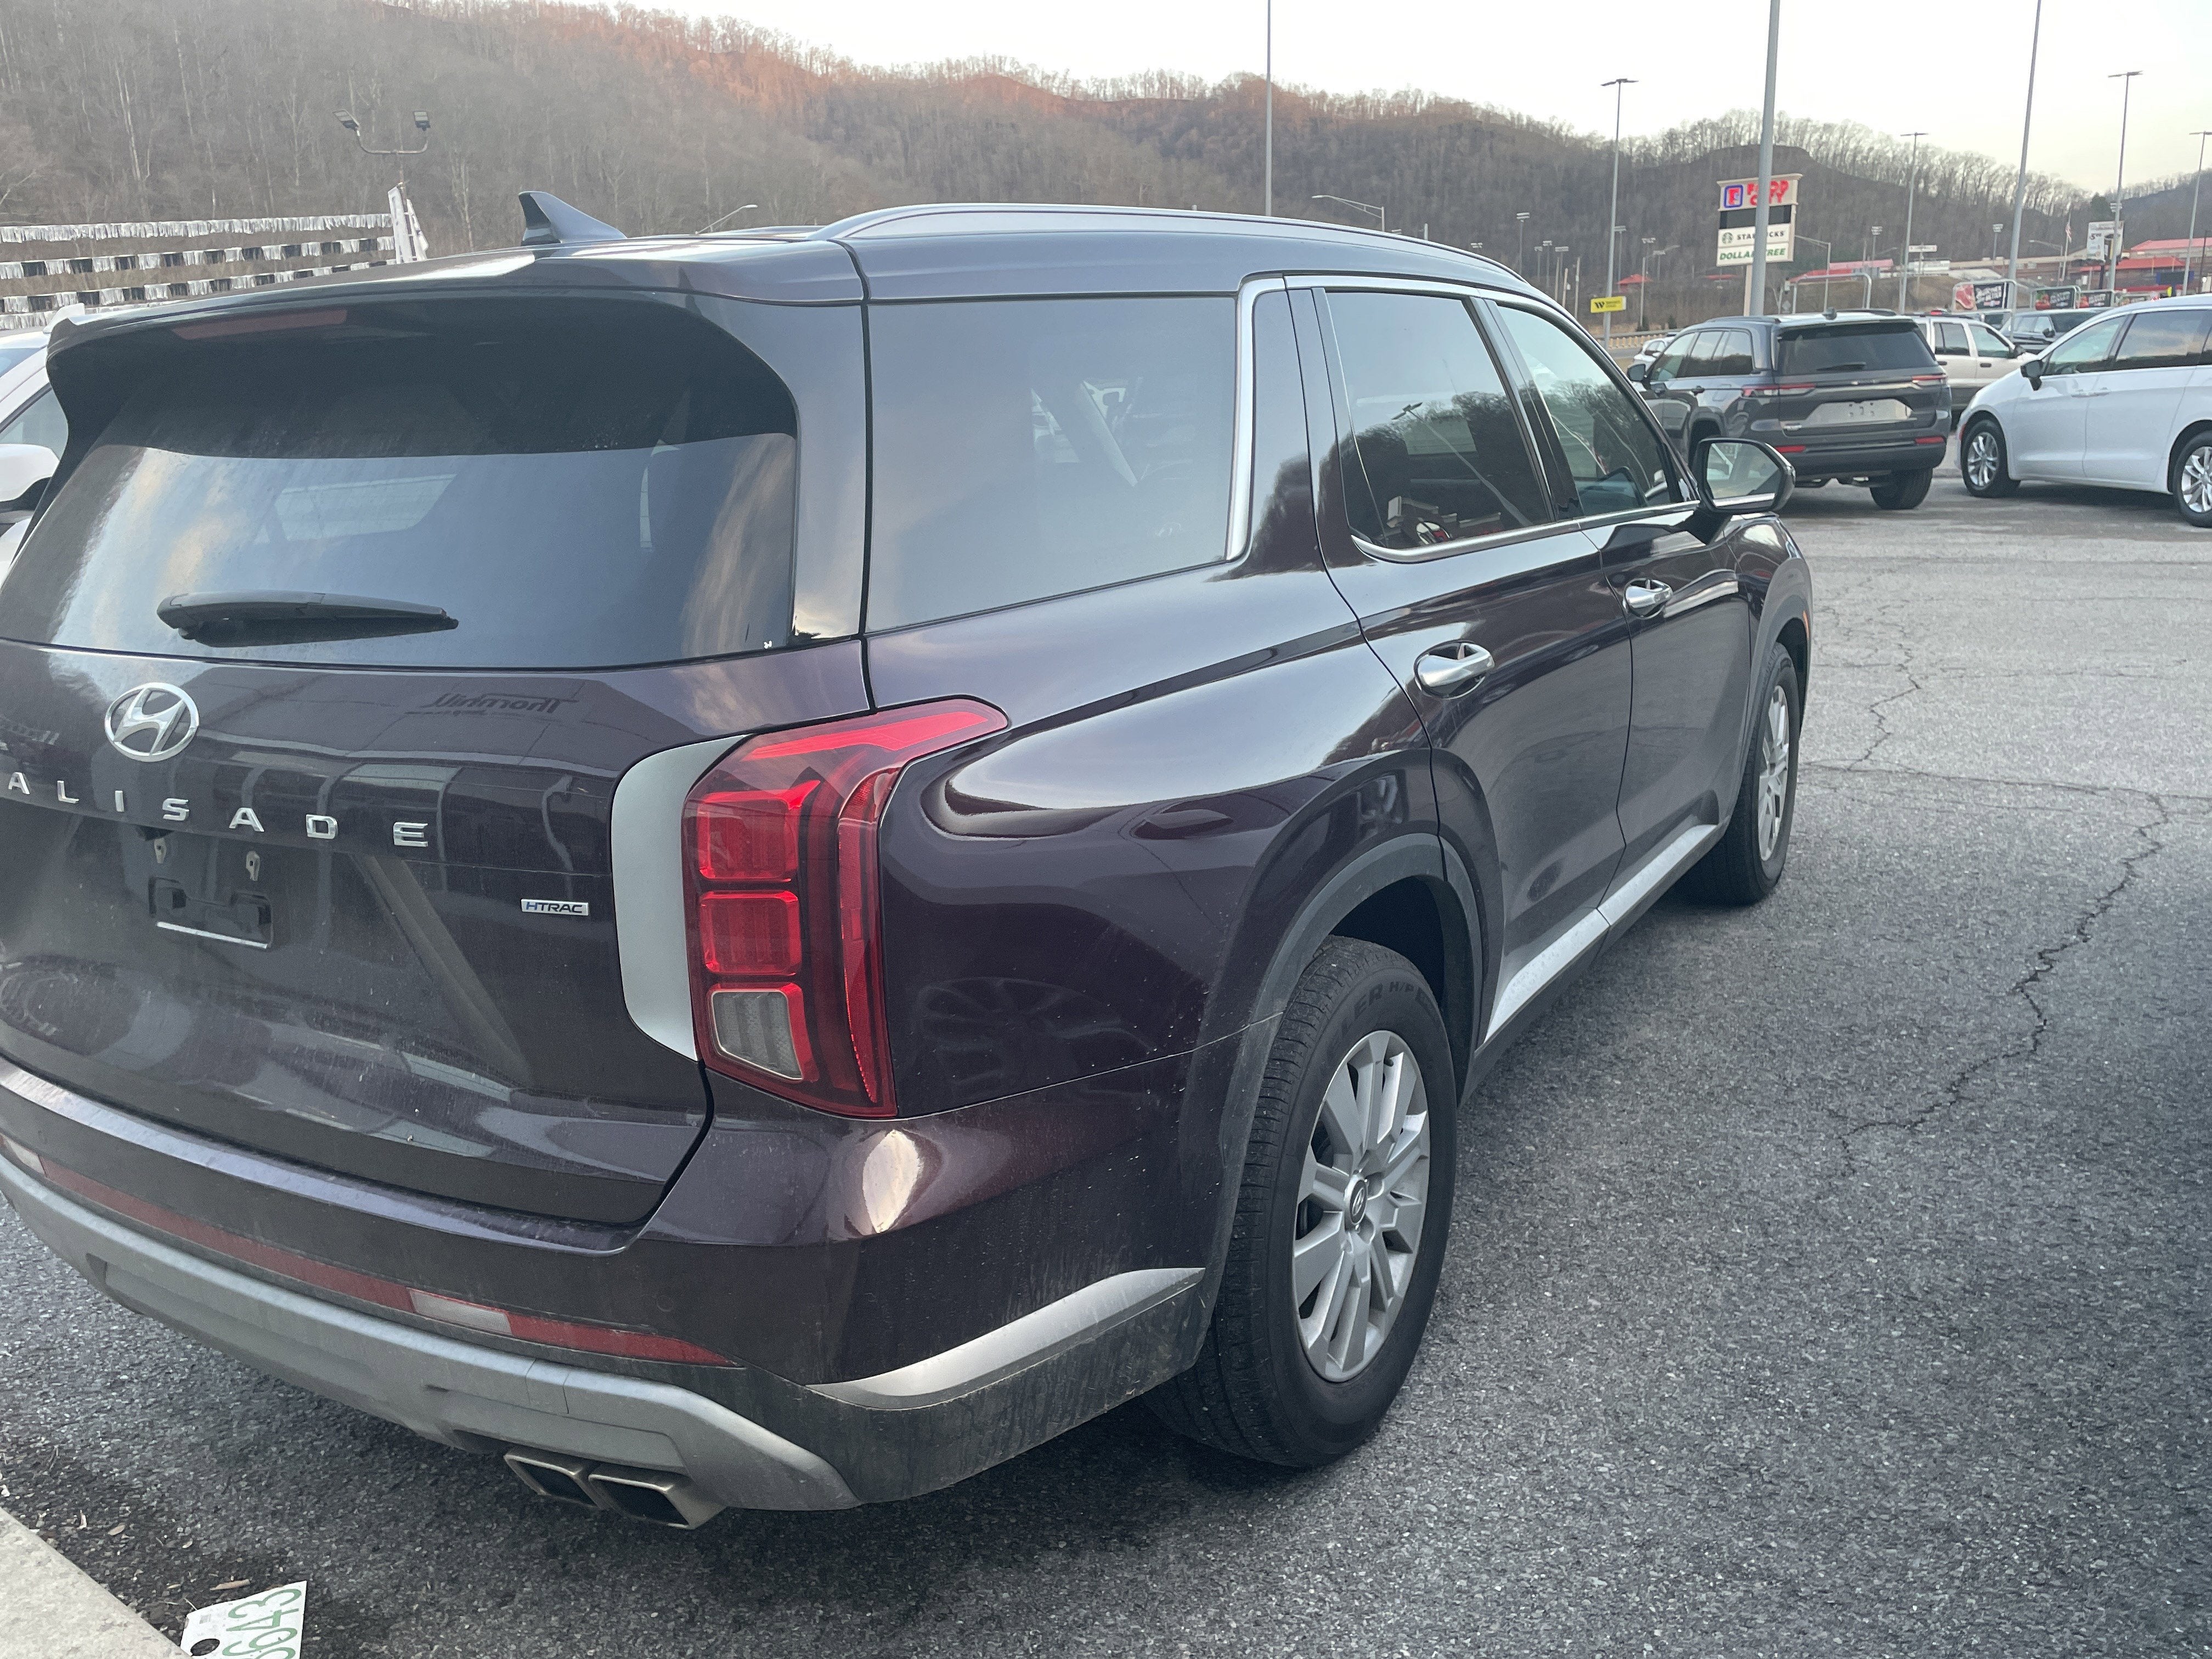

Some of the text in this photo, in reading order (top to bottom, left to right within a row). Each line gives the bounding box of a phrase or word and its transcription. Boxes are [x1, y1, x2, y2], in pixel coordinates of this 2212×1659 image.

[1737, 230, 1785, 240] STACKS
[1720, 248, 1786, 261] DOLLA REE
[526, 901, 583, 913] HTRAC
